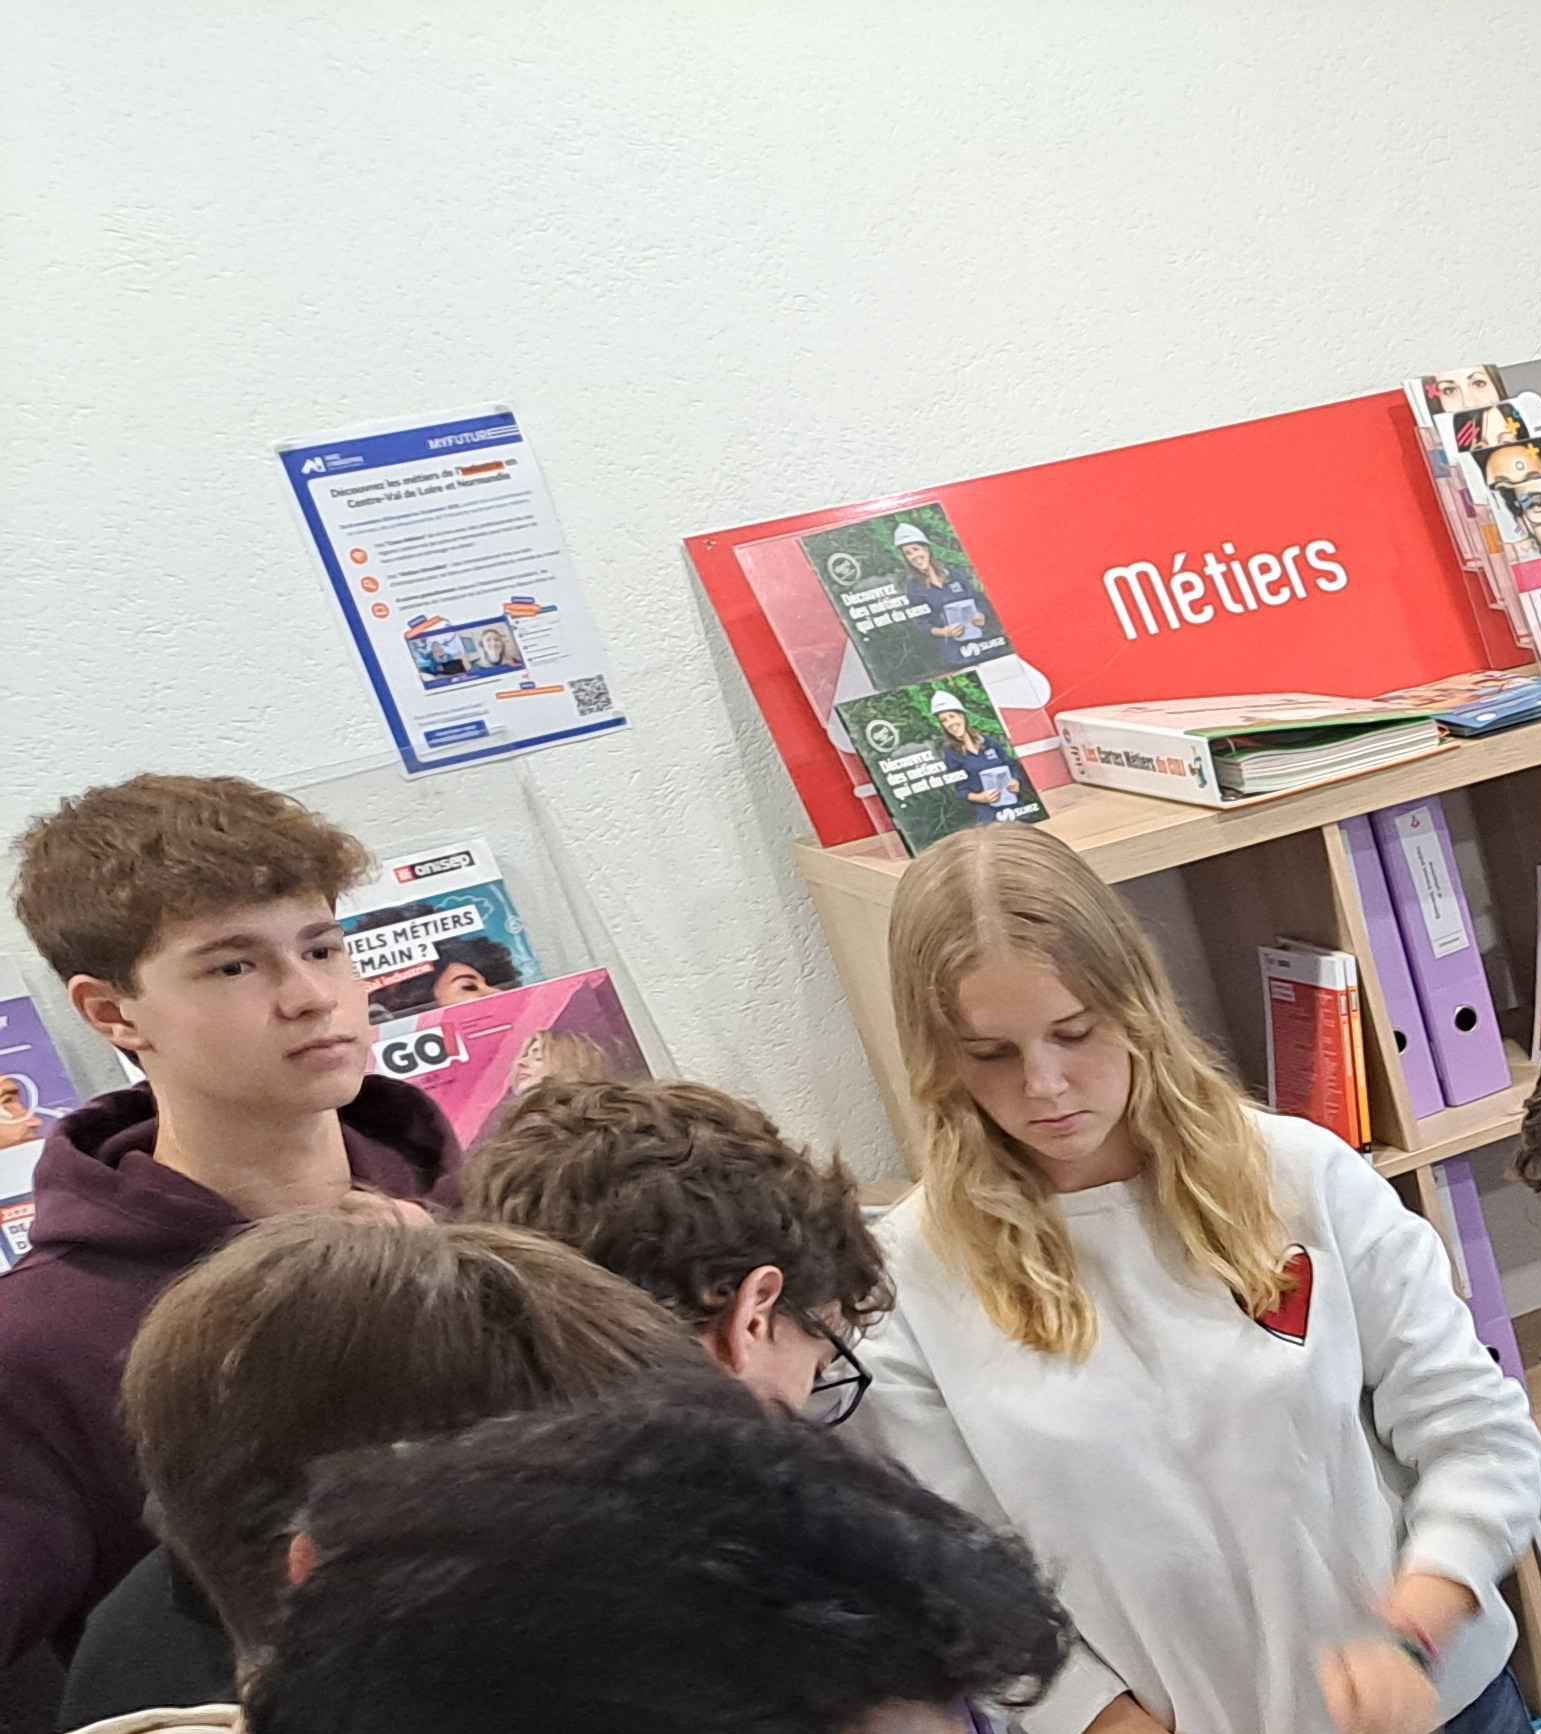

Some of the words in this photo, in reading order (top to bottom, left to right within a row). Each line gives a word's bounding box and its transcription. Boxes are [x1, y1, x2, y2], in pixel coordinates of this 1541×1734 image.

[1103, 540, 1349, 641] Métiers
[415, 853, 470, 876] onisep
[393, 911, 474, 943] MÉTIERS
